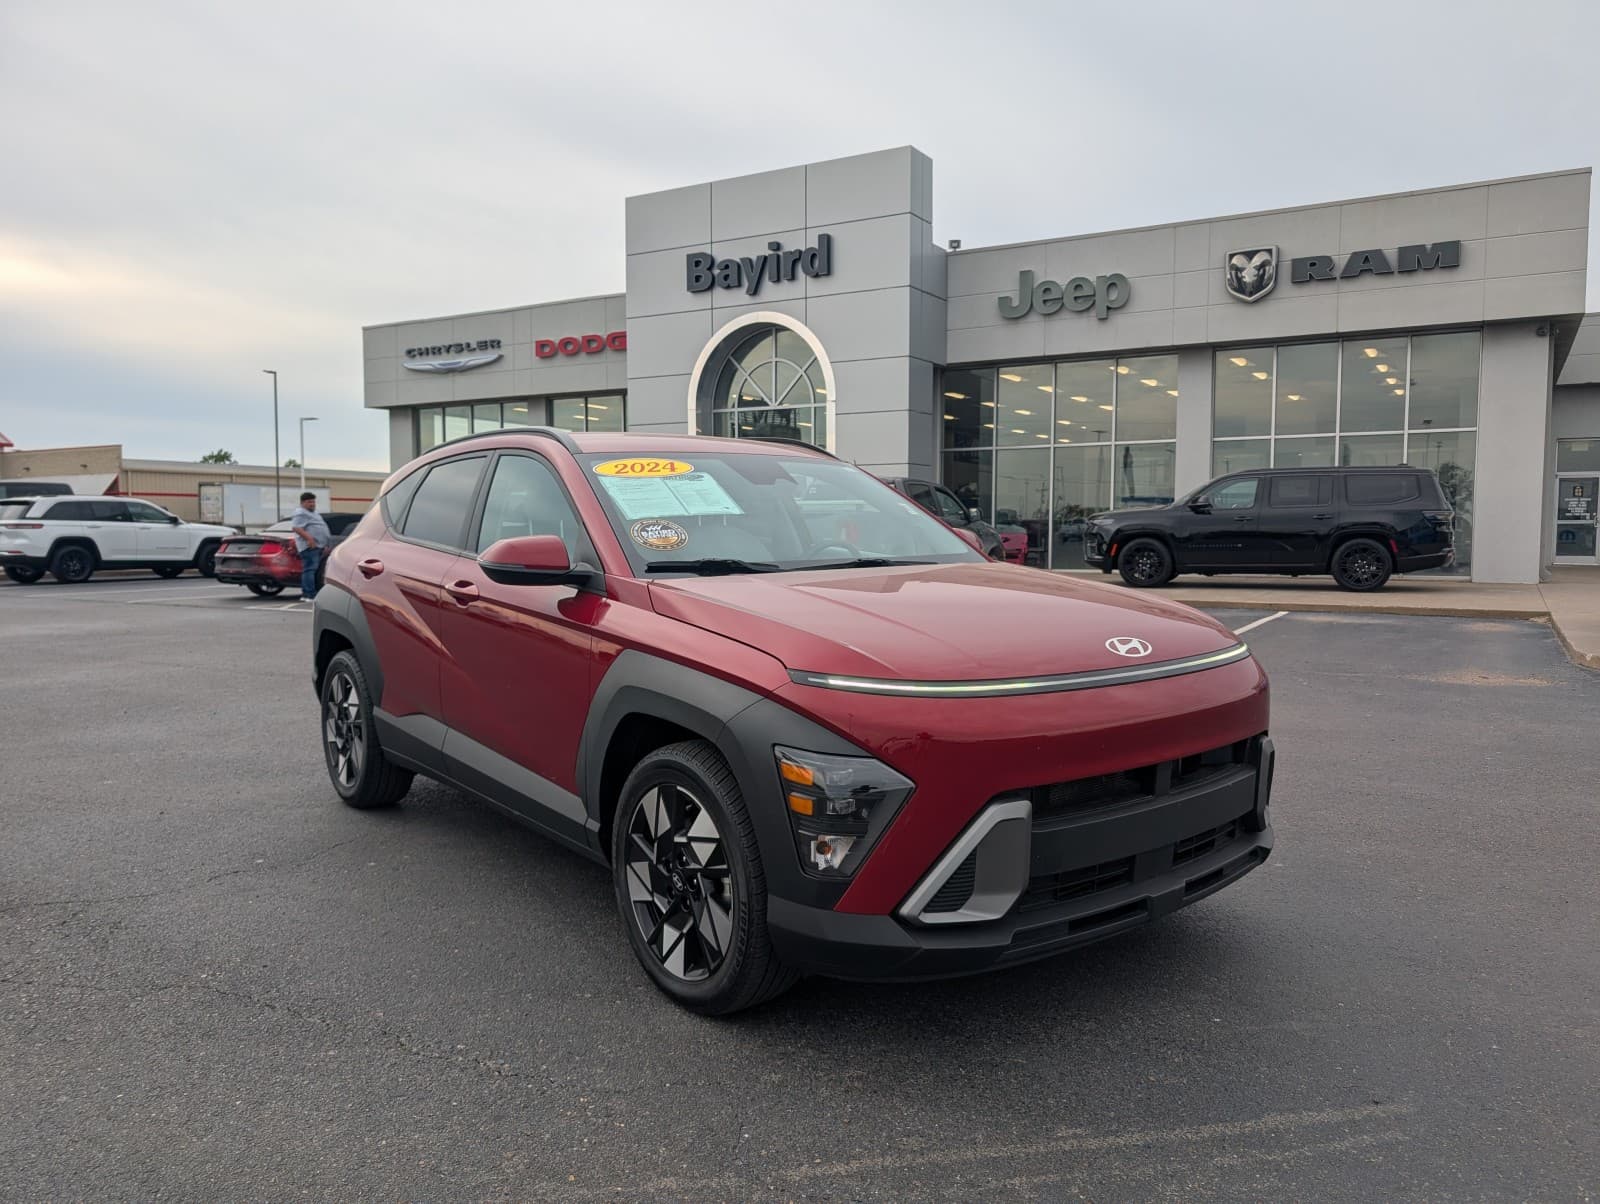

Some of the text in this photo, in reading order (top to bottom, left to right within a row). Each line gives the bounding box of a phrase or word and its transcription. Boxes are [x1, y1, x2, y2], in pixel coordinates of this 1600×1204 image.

[686, 233, 833, 296] Bayird
[1291, 240, 1461, 283] RAM
[998, 270, 1130, 320] Jeep
[405, 339, 502, 358] CHRYSLER
[614, 461, 678, 474] 2024
